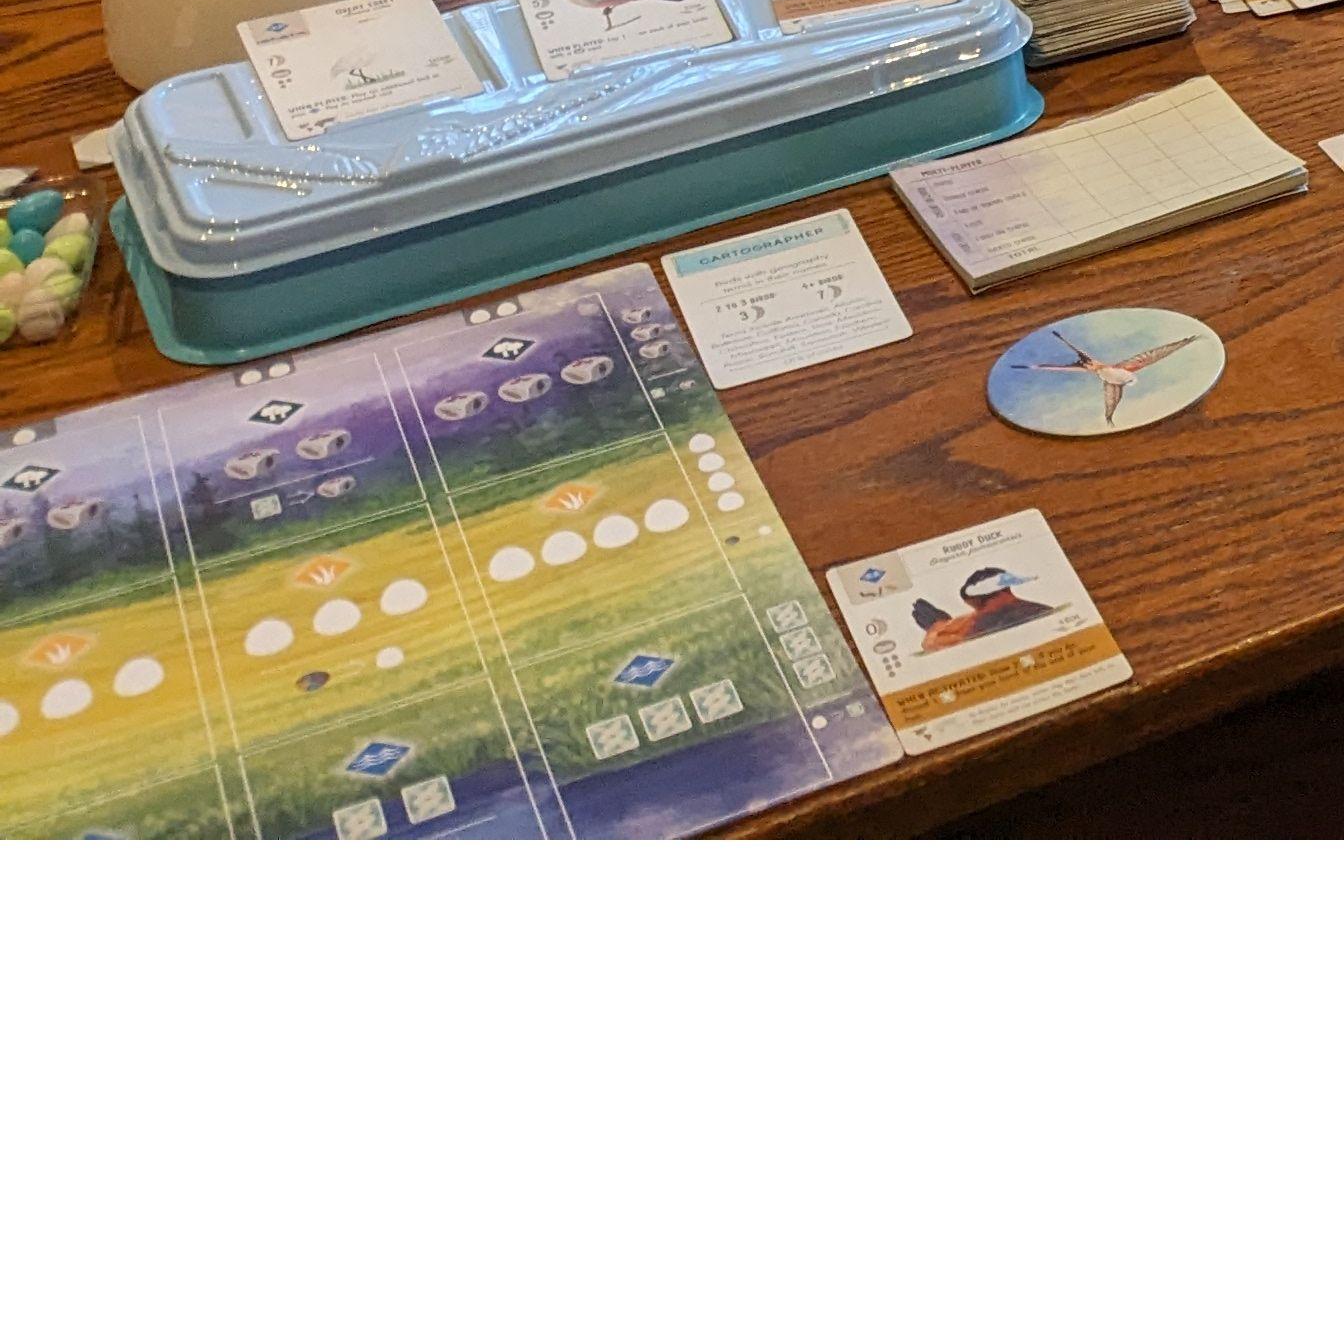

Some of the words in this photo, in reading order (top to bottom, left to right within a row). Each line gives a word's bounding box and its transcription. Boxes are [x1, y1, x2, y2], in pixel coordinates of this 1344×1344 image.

[699, 227, 825, 266] CARTOGRAPHER
[739, 311, 749, 321] 3
[941, 540, 974, 555] RUDDY
[976, 529, 1004, 545] DUCK
